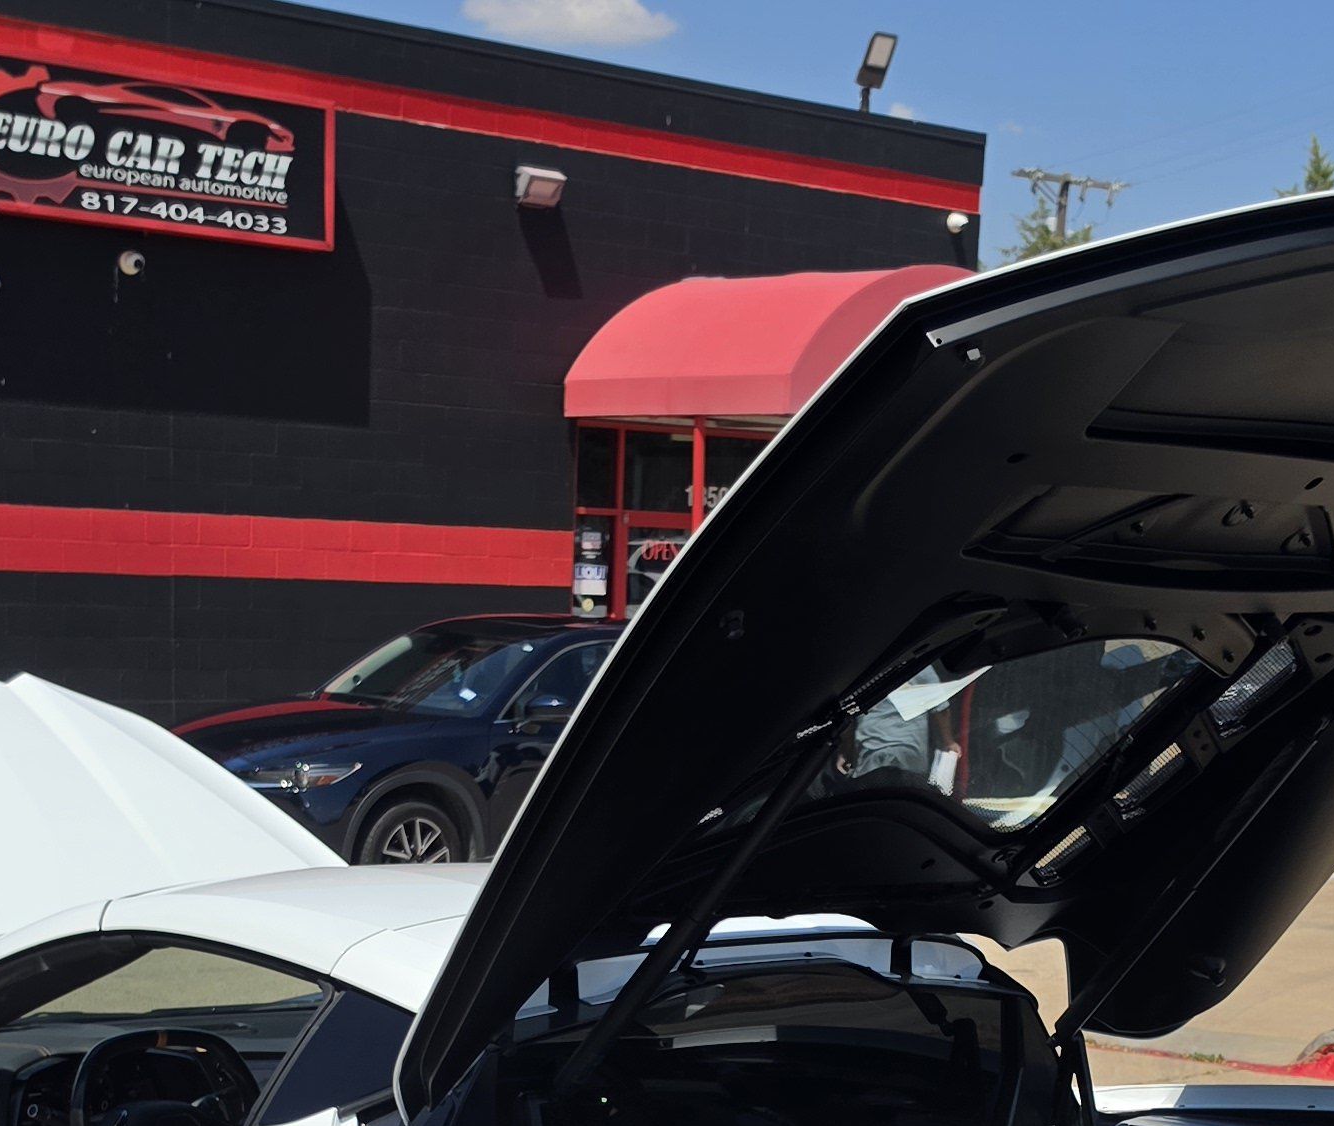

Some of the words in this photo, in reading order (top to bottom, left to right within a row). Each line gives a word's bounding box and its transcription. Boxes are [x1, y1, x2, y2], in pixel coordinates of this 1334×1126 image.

[105, 130, 185, 174] CAR
[195, 143, 294, 190] TECH
[78, 162, 175, 190] european
[179, 175, 288, 205] automotive
[80, 191, 288, 234] 817-404-4033
